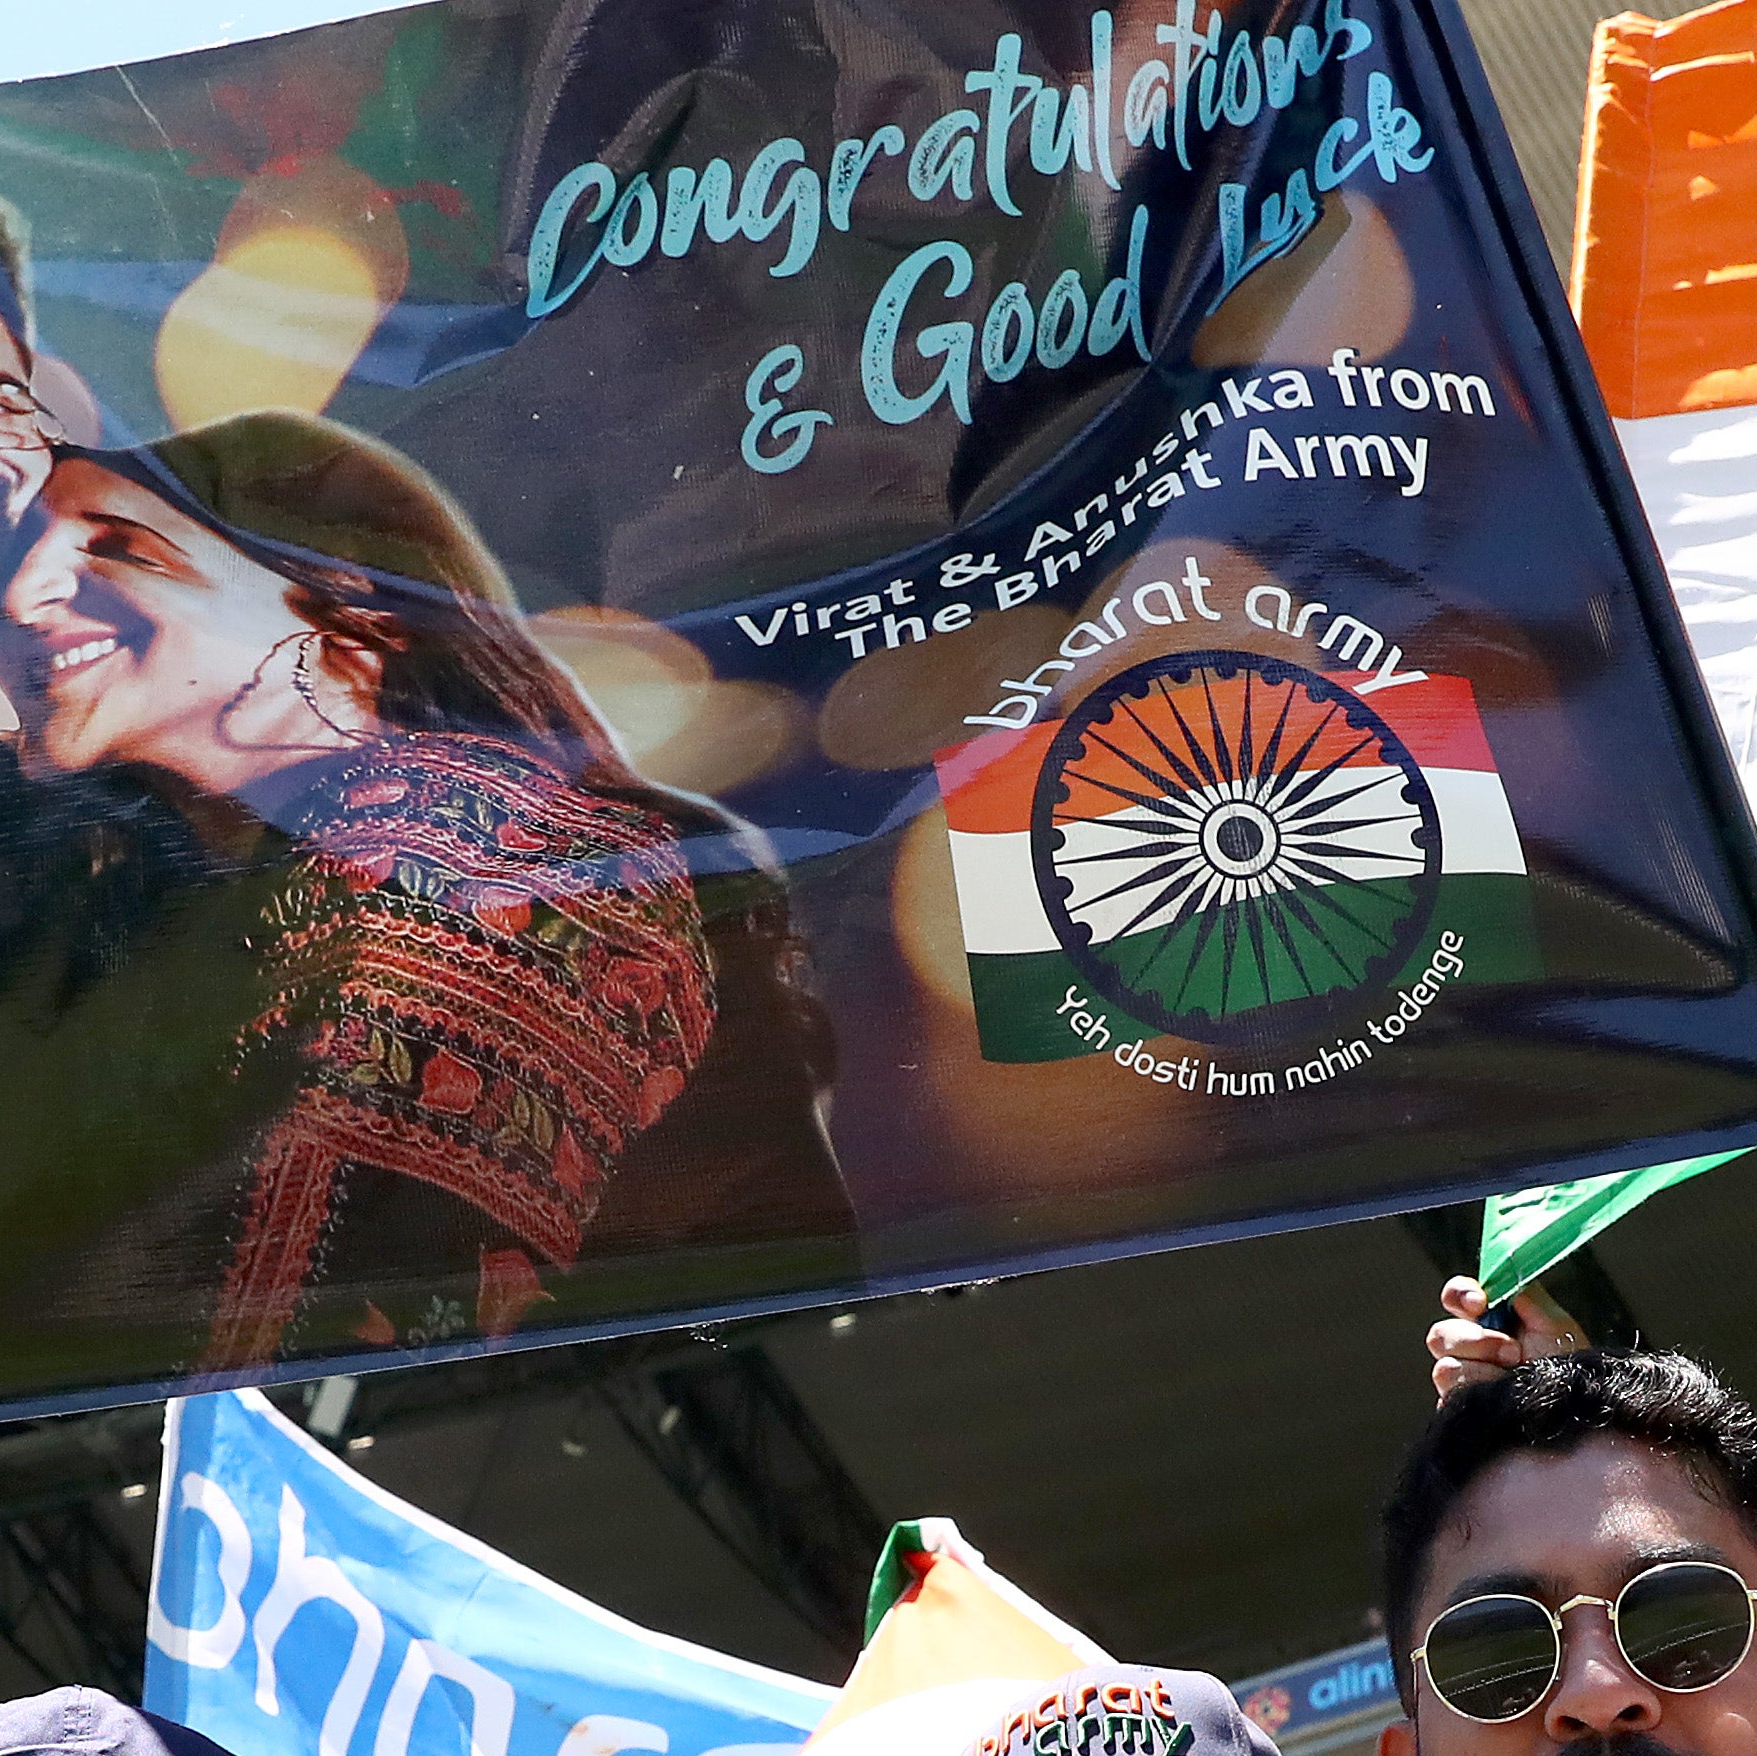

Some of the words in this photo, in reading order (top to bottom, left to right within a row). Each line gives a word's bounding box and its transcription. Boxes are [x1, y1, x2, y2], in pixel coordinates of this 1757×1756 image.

[526, 0, 1374, 318] Congratulations
[741, 343, 834, 474] &
[860, 204, 1153, 426] Good
[1206, 70, 1436, 317] Luck
[733, 576, 916, 649] Virat
[938, 552, 1002, 590] &
[1024, 363, 1315, 559] Anushka
[1327, 347, 1498, 418] from
[834, 602, 974, 660] The
[993, 446, 1223, 614] Bharat
[1243, 426, 1430, 497] Army
[962, 555, 1224, 732] bharat
[1243, 581, 1430, 699] army
[1055, 984, 1113, 1051] Yeh
[1113, 1038, 1201, 1092] dosti
[1205, 1061, 1275, 1097] hum
[1284, 1037, 1374, 1092] nahin
[1365, 929, 1465, 1045] todenge
